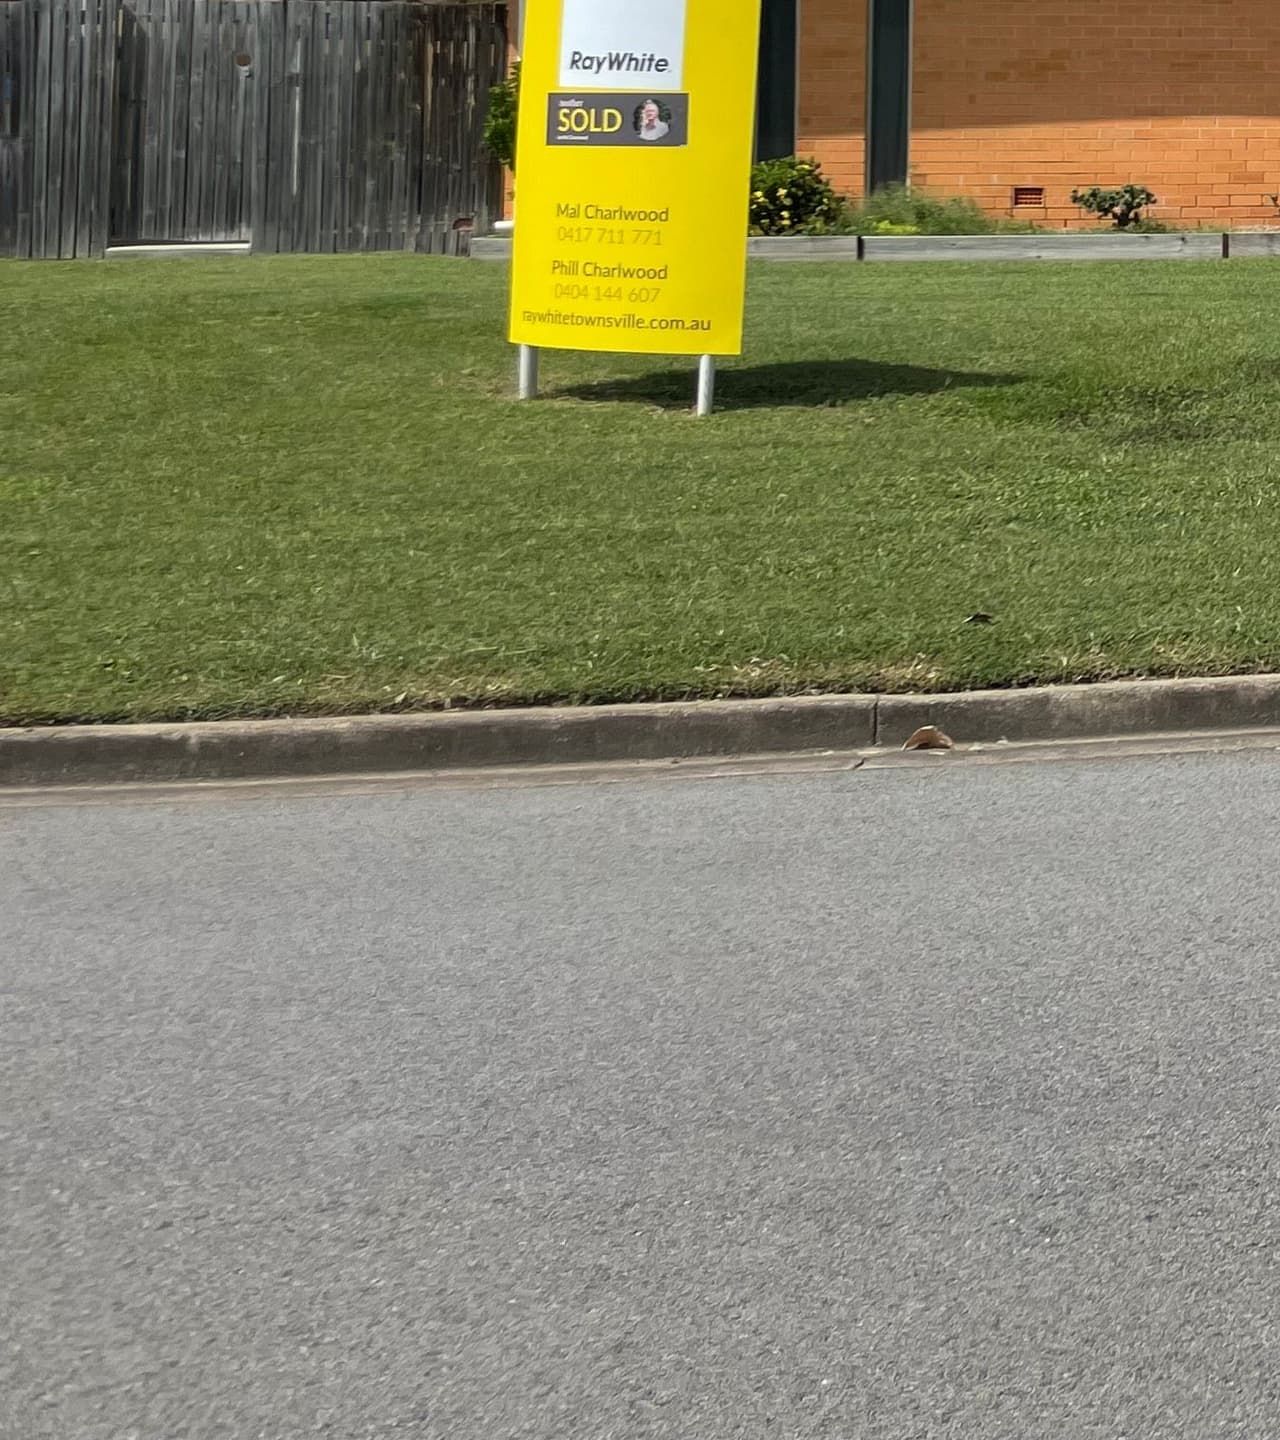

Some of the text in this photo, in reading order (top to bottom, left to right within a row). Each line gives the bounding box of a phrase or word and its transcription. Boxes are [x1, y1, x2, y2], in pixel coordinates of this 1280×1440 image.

[557, 108, 622, 132] SOLD
[556, 203, 669, 222] Mal Charlwood
[558, 226, 662, 246] 0417 711 771
[552, 261, 668, 280] Phill Charlwood
[554, 283, 661, 303] 0404 144 607
[522, 308, 711, 330] raywhitetownsville.com.au
